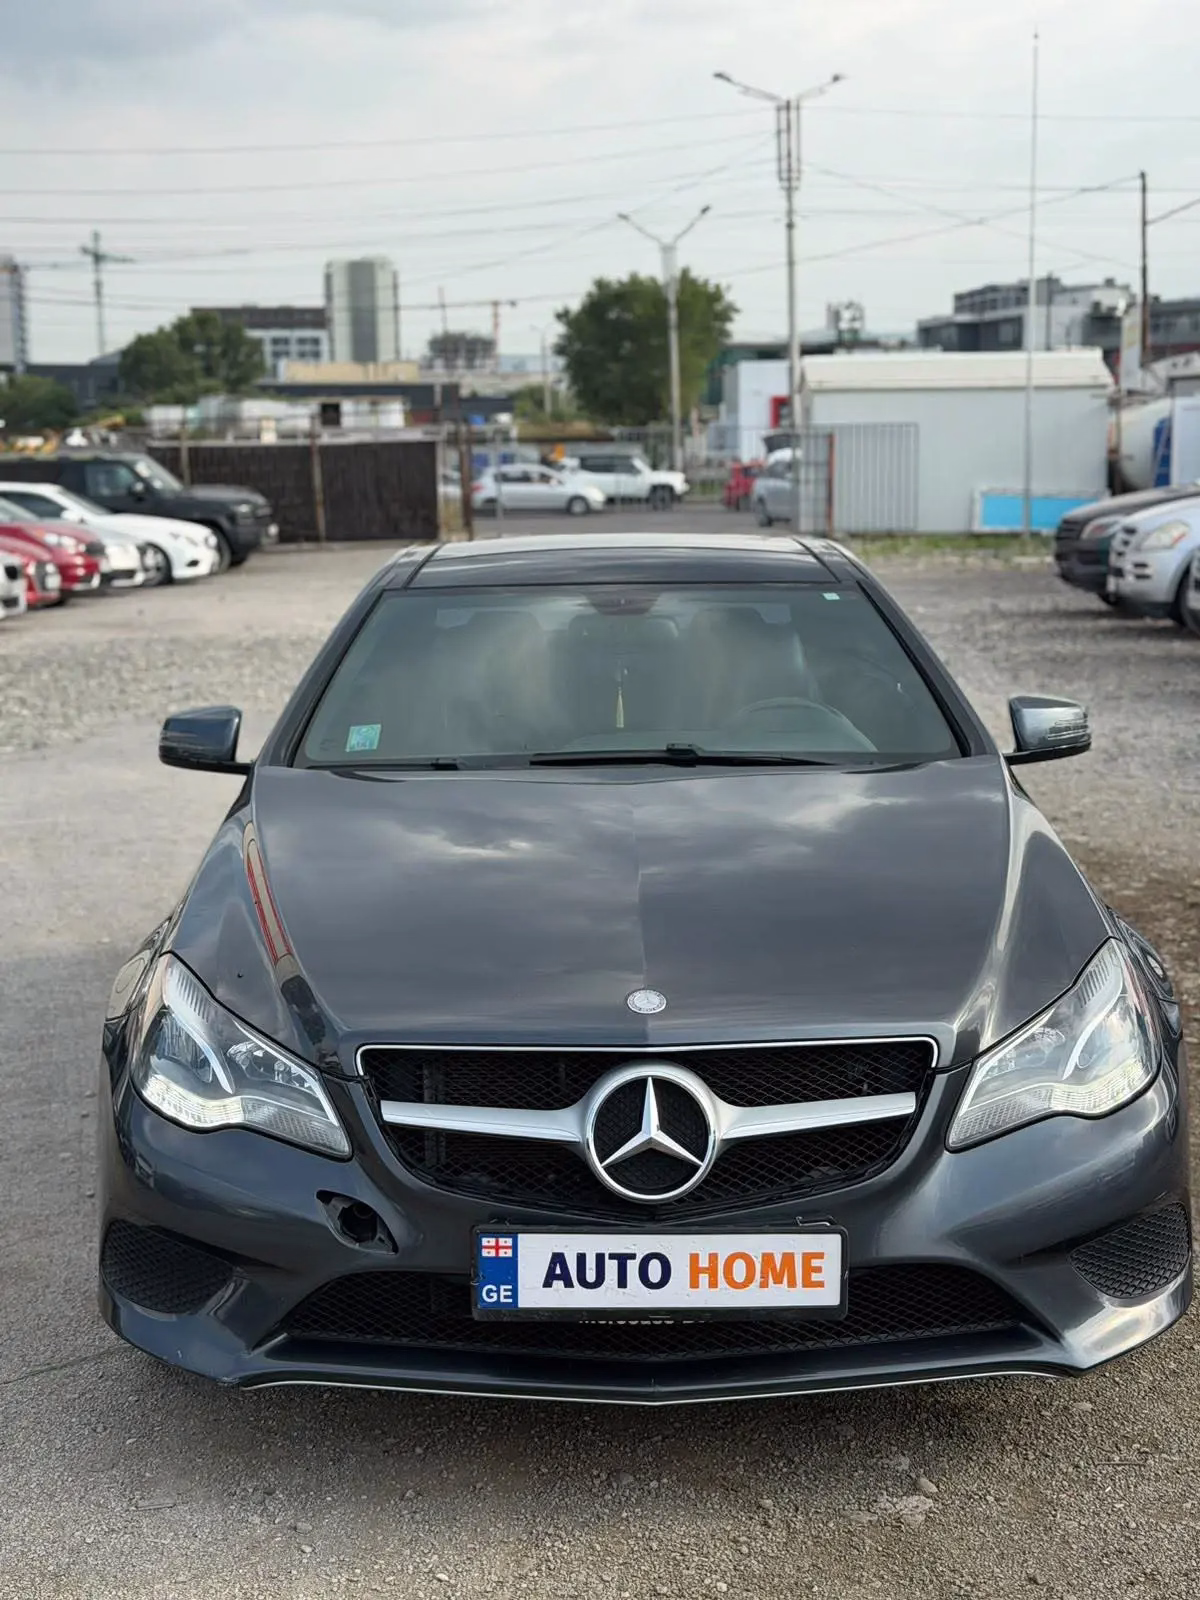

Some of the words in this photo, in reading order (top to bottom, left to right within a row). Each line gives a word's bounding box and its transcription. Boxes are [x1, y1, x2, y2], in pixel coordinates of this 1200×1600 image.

[542, 1252, 672, 1289] AUTO
[688, 1252, 826, 1289] HOME
[481, 1284, 513, 1303] GE
